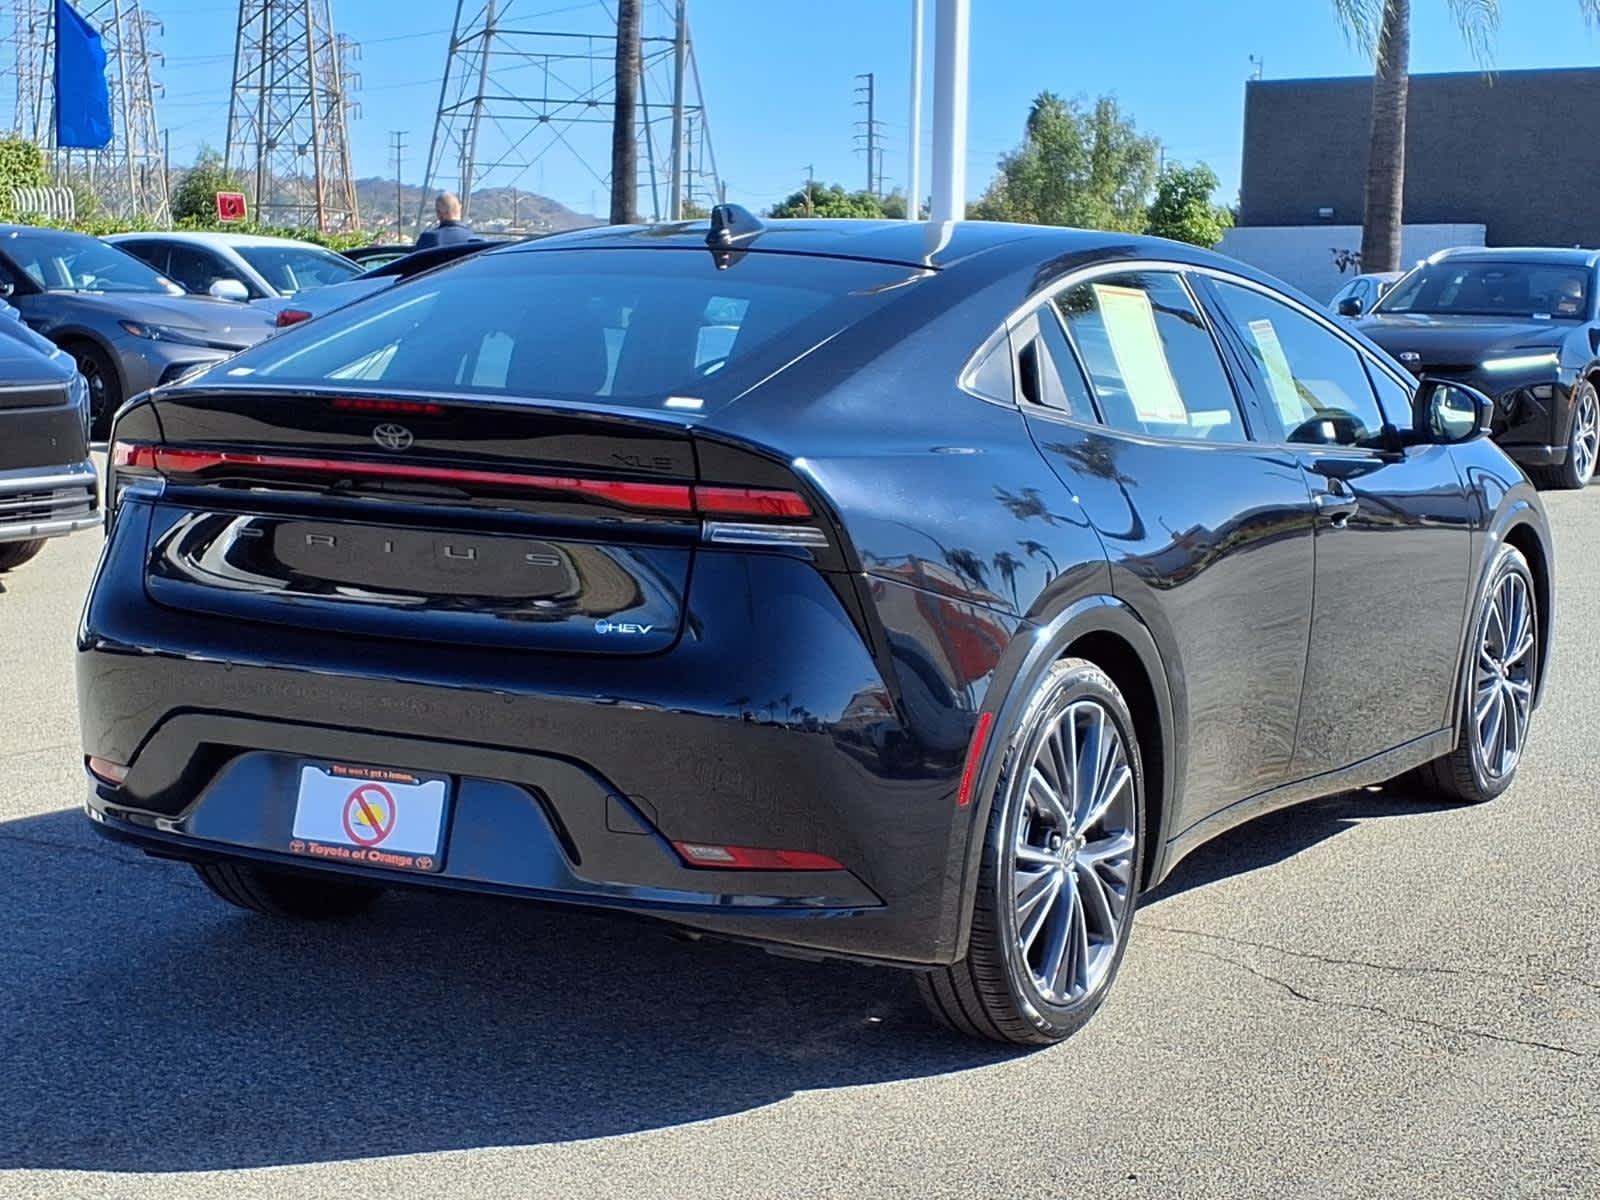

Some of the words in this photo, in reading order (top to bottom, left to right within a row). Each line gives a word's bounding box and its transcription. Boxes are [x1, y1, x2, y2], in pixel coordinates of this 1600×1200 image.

[611, 453, 672, 470] XLE
[237, 528, 560, 566] PRIUS
[608, 623, 653, 634] HEV
[309, 842, 350, 857] Toyota
[351, 850, 366, 860] of
[368, 850, 412, 866] Orange
